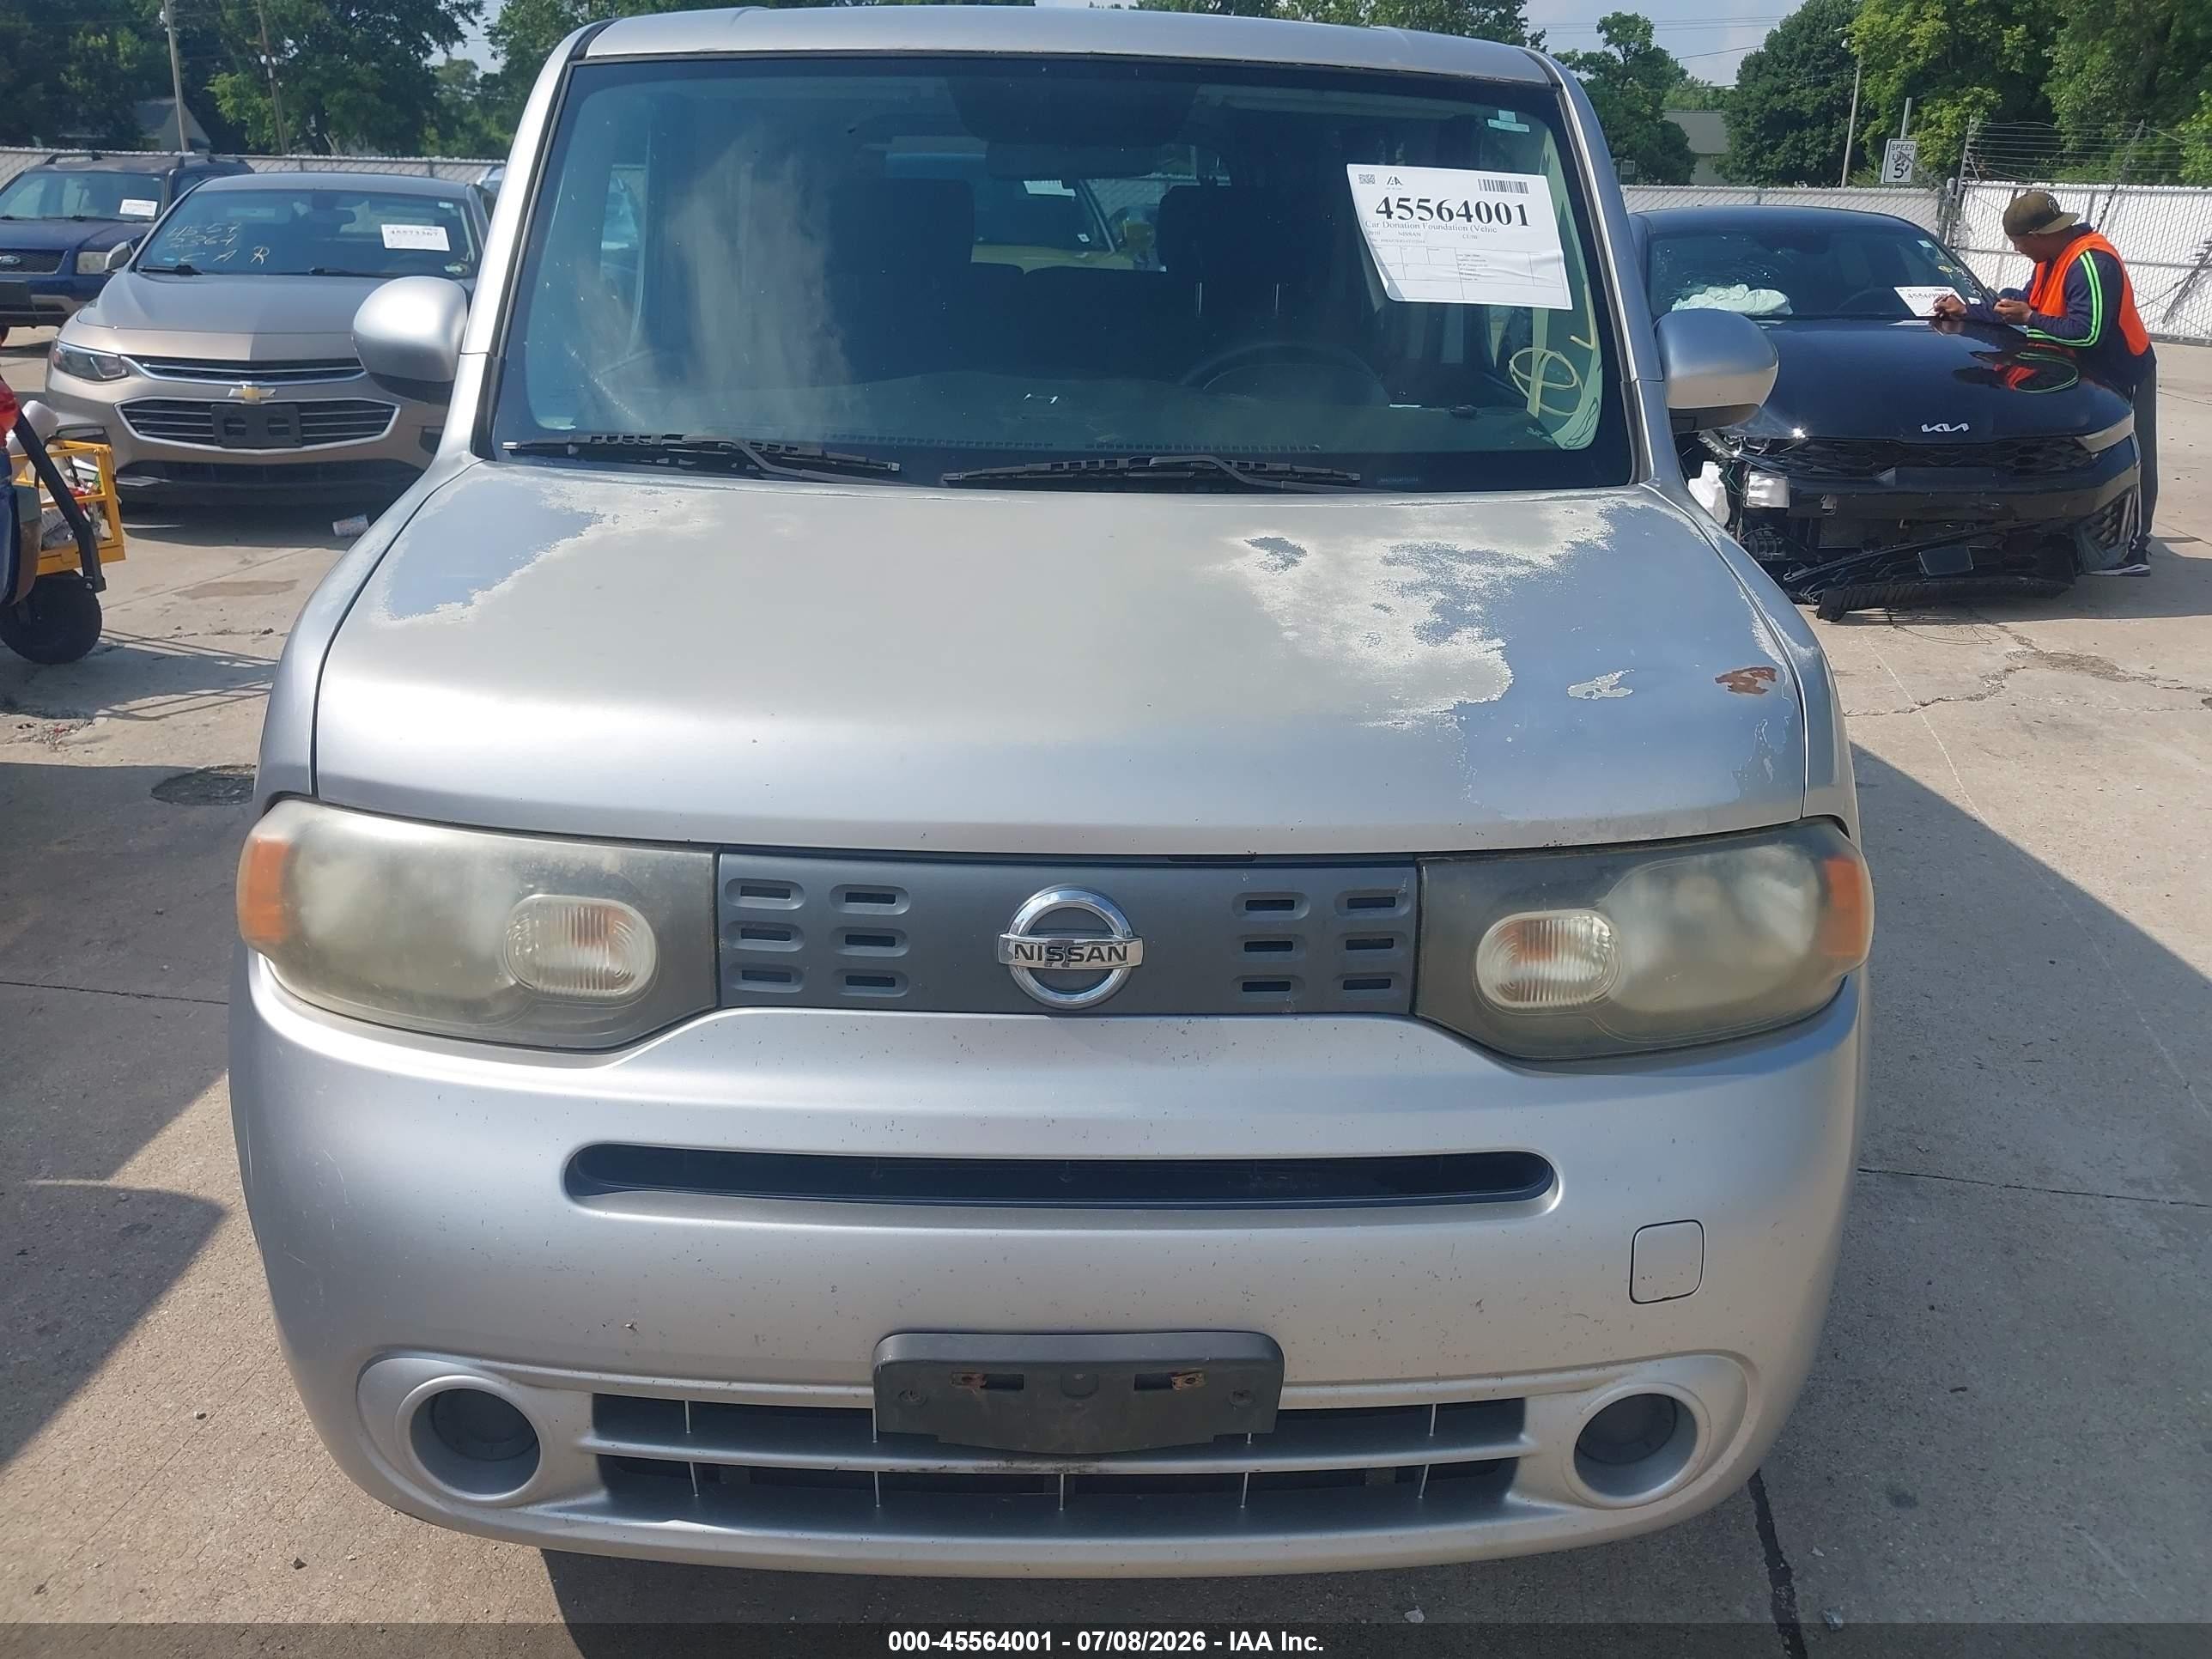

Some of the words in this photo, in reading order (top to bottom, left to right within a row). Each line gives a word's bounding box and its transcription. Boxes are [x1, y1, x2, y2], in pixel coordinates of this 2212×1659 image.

[1376, 196, 1531, 228] 45564001
[1364, 220, 1380, 228] Car
[1382, 221, 1420, 229] Donation
[1423, 222, 1468, 232] Foundation
[1470, 224, 1498, 234] (Vehic
[1921, 423, 1970, 433] KIA
[1014, 944, 1127, 963] NISSAN
